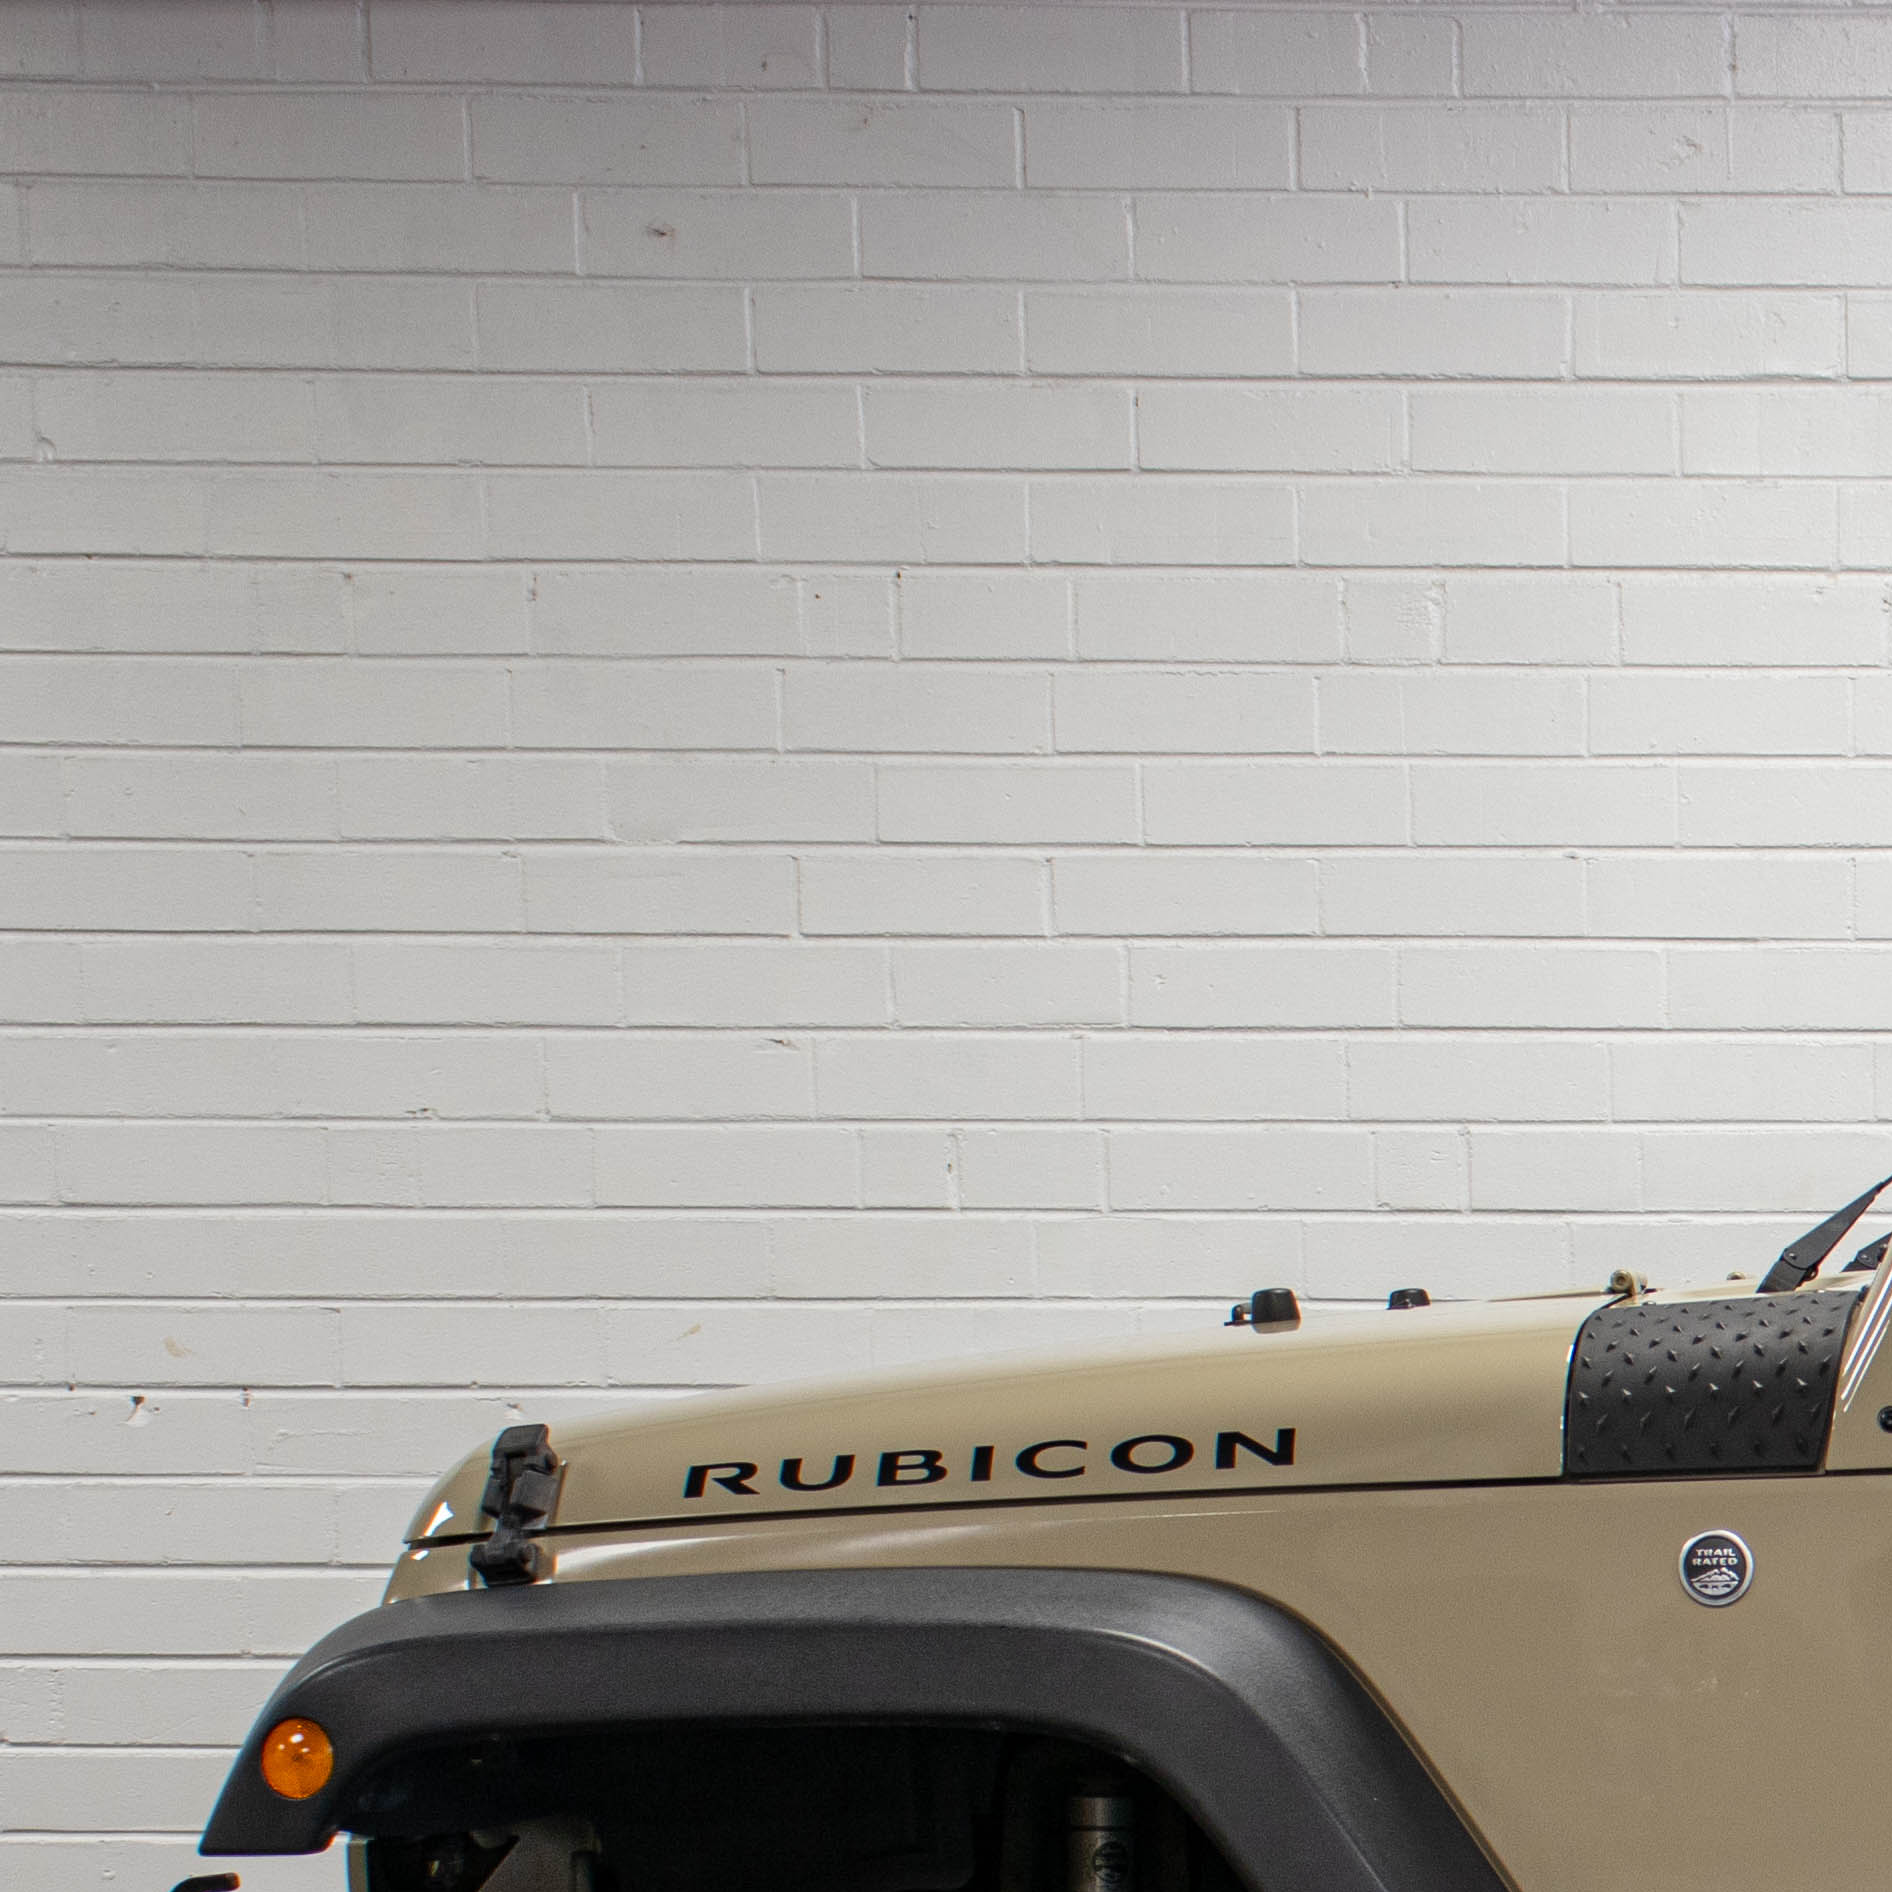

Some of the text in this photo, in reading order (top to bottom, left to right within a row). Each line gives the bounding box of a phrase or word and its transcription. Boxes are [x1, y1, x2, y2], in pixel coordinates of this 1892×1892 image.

[683, 1427, 1297, 1499] RUBICON
[1696, 1548, 1737, 1557] TRAIL
[1692, 1557, 1739, 1566] RATED
